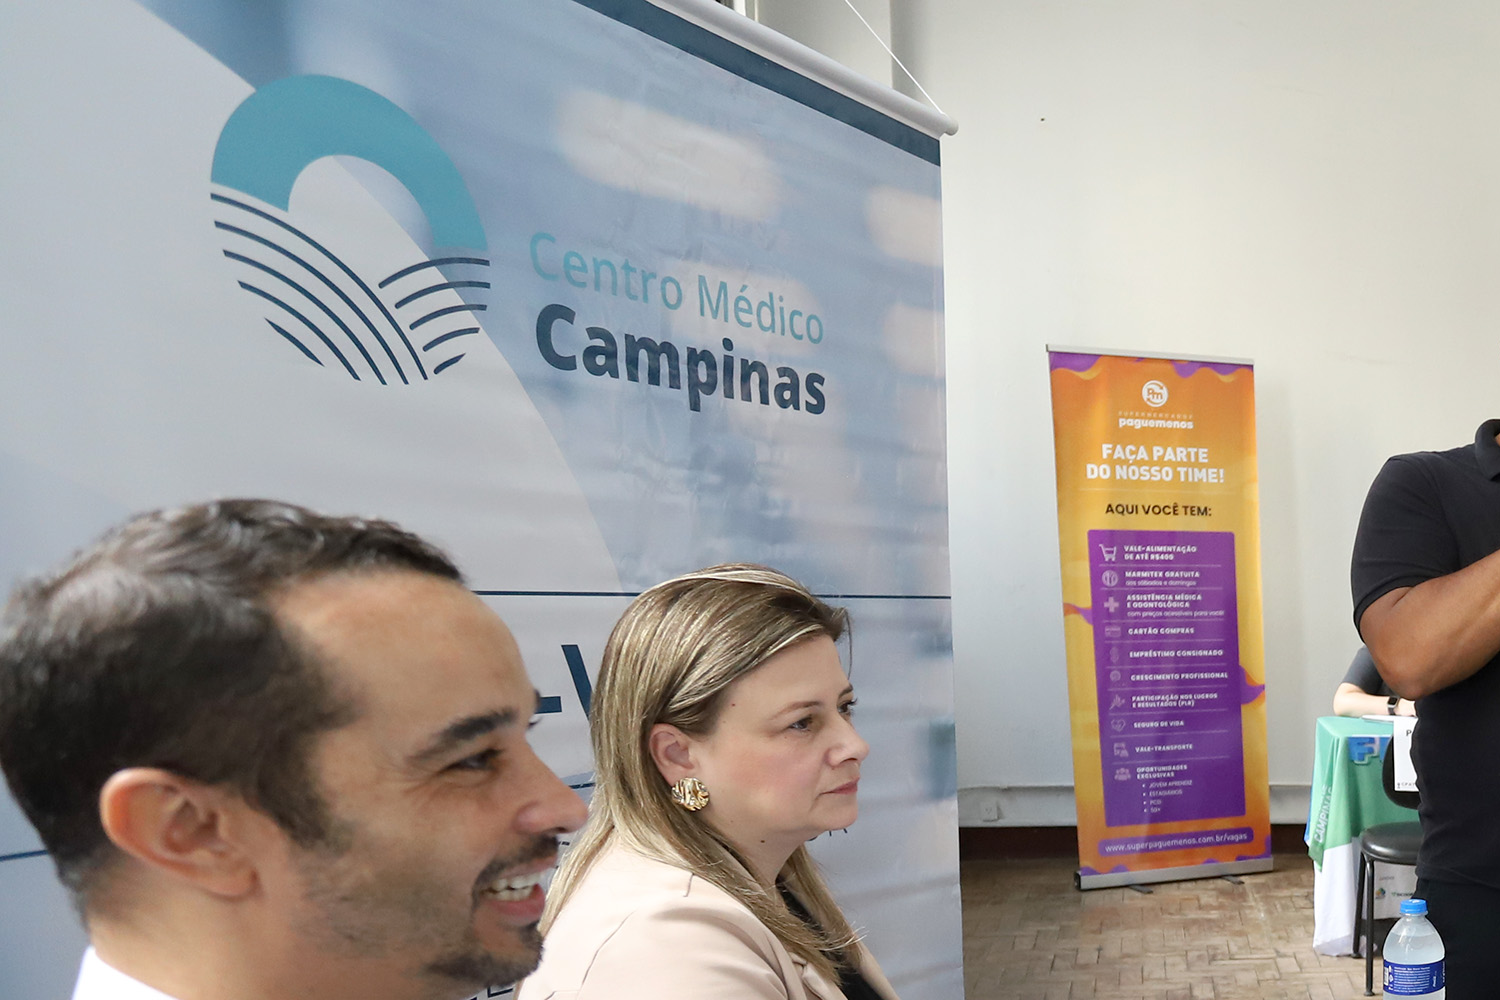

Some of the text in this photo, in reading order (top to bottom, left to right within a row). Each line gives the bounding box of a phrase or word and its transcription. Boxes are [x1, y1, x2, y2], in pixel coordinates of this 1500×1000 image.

[530, 232, 824, 344] Centro Médico
[535, 303, 826, 415] Campinas
[1118, 418, 1194, 429] paguemenos
[1101, 443, 1209, 463] FAÇA PARTE
[1086, 463, 1225, 483] DO NOSSO TIME!
[1105, 502, 1212, 516] AQUI VOCÊ TEM:
[1105, 832, 1247, 852] www.superpaguemenos.com.br/vagas
